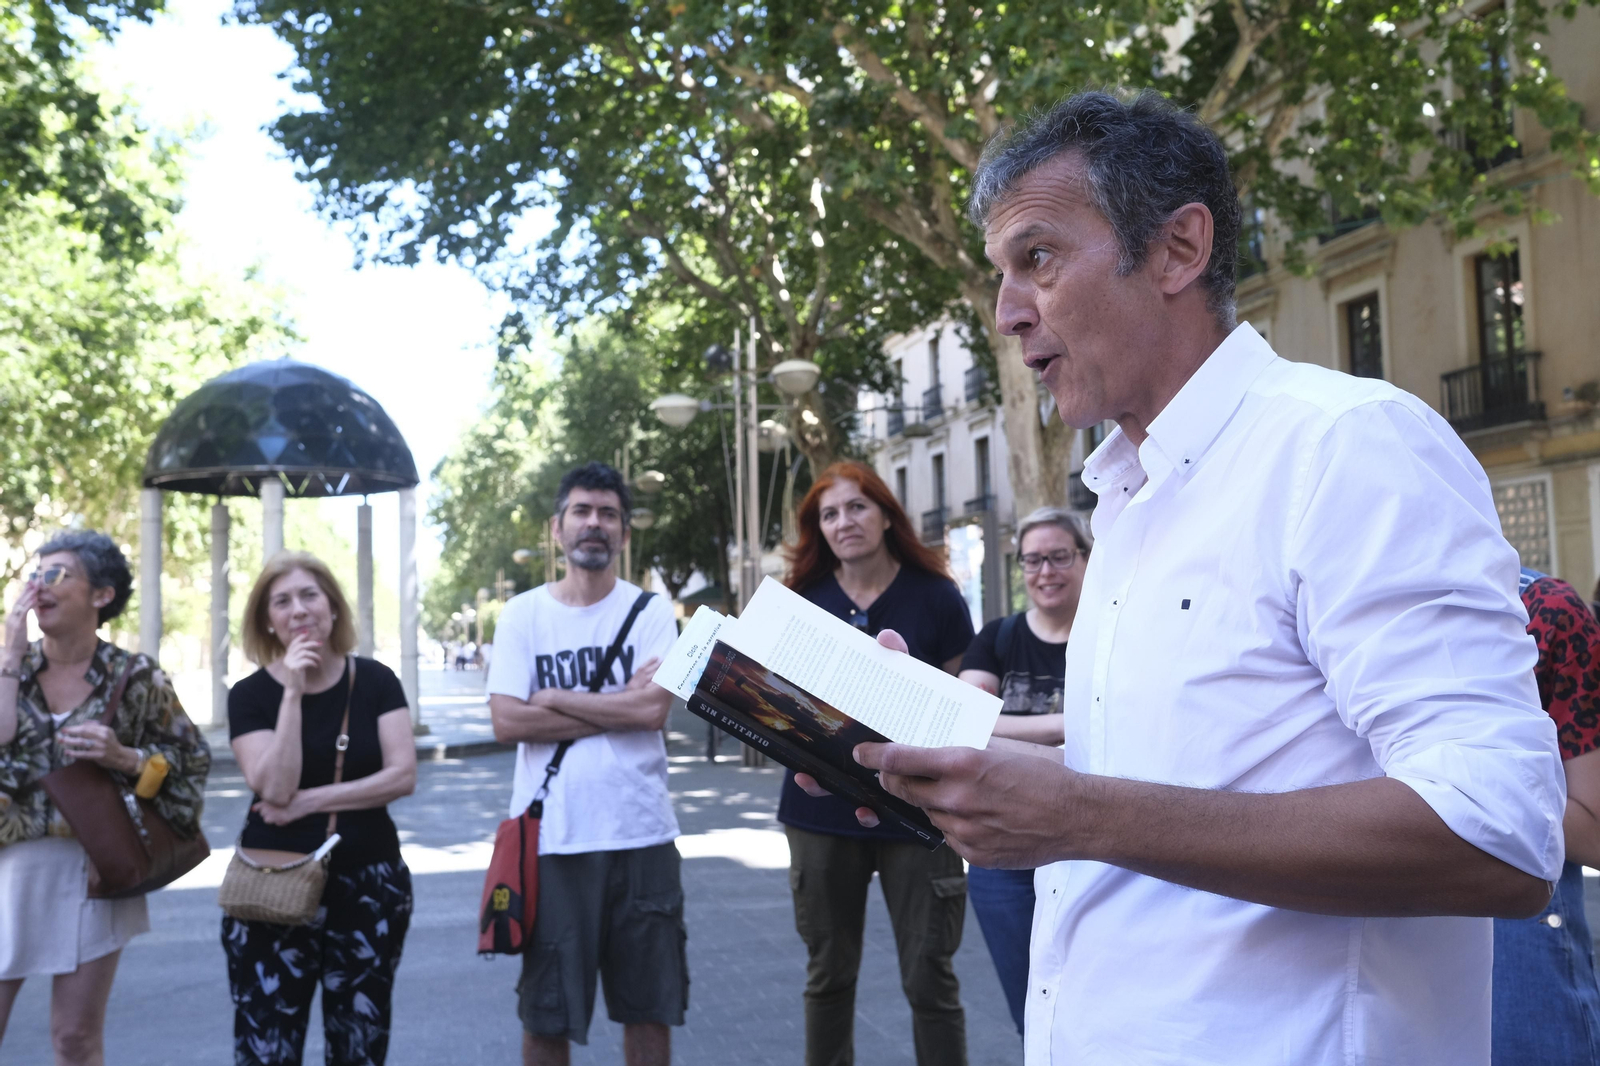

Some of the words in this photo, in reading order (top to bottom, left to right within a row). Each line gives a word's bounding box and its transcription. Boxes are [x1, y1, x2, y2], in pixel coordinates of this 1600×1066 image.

[706, 623, 722, 646] narrativa
[536, 645, 635, 689] ROCKY
[687, 645, 698, 658] Ciclo
[700, 703, 717, 717] SIN
[721, 717, 770, 748] EPITAFIO
